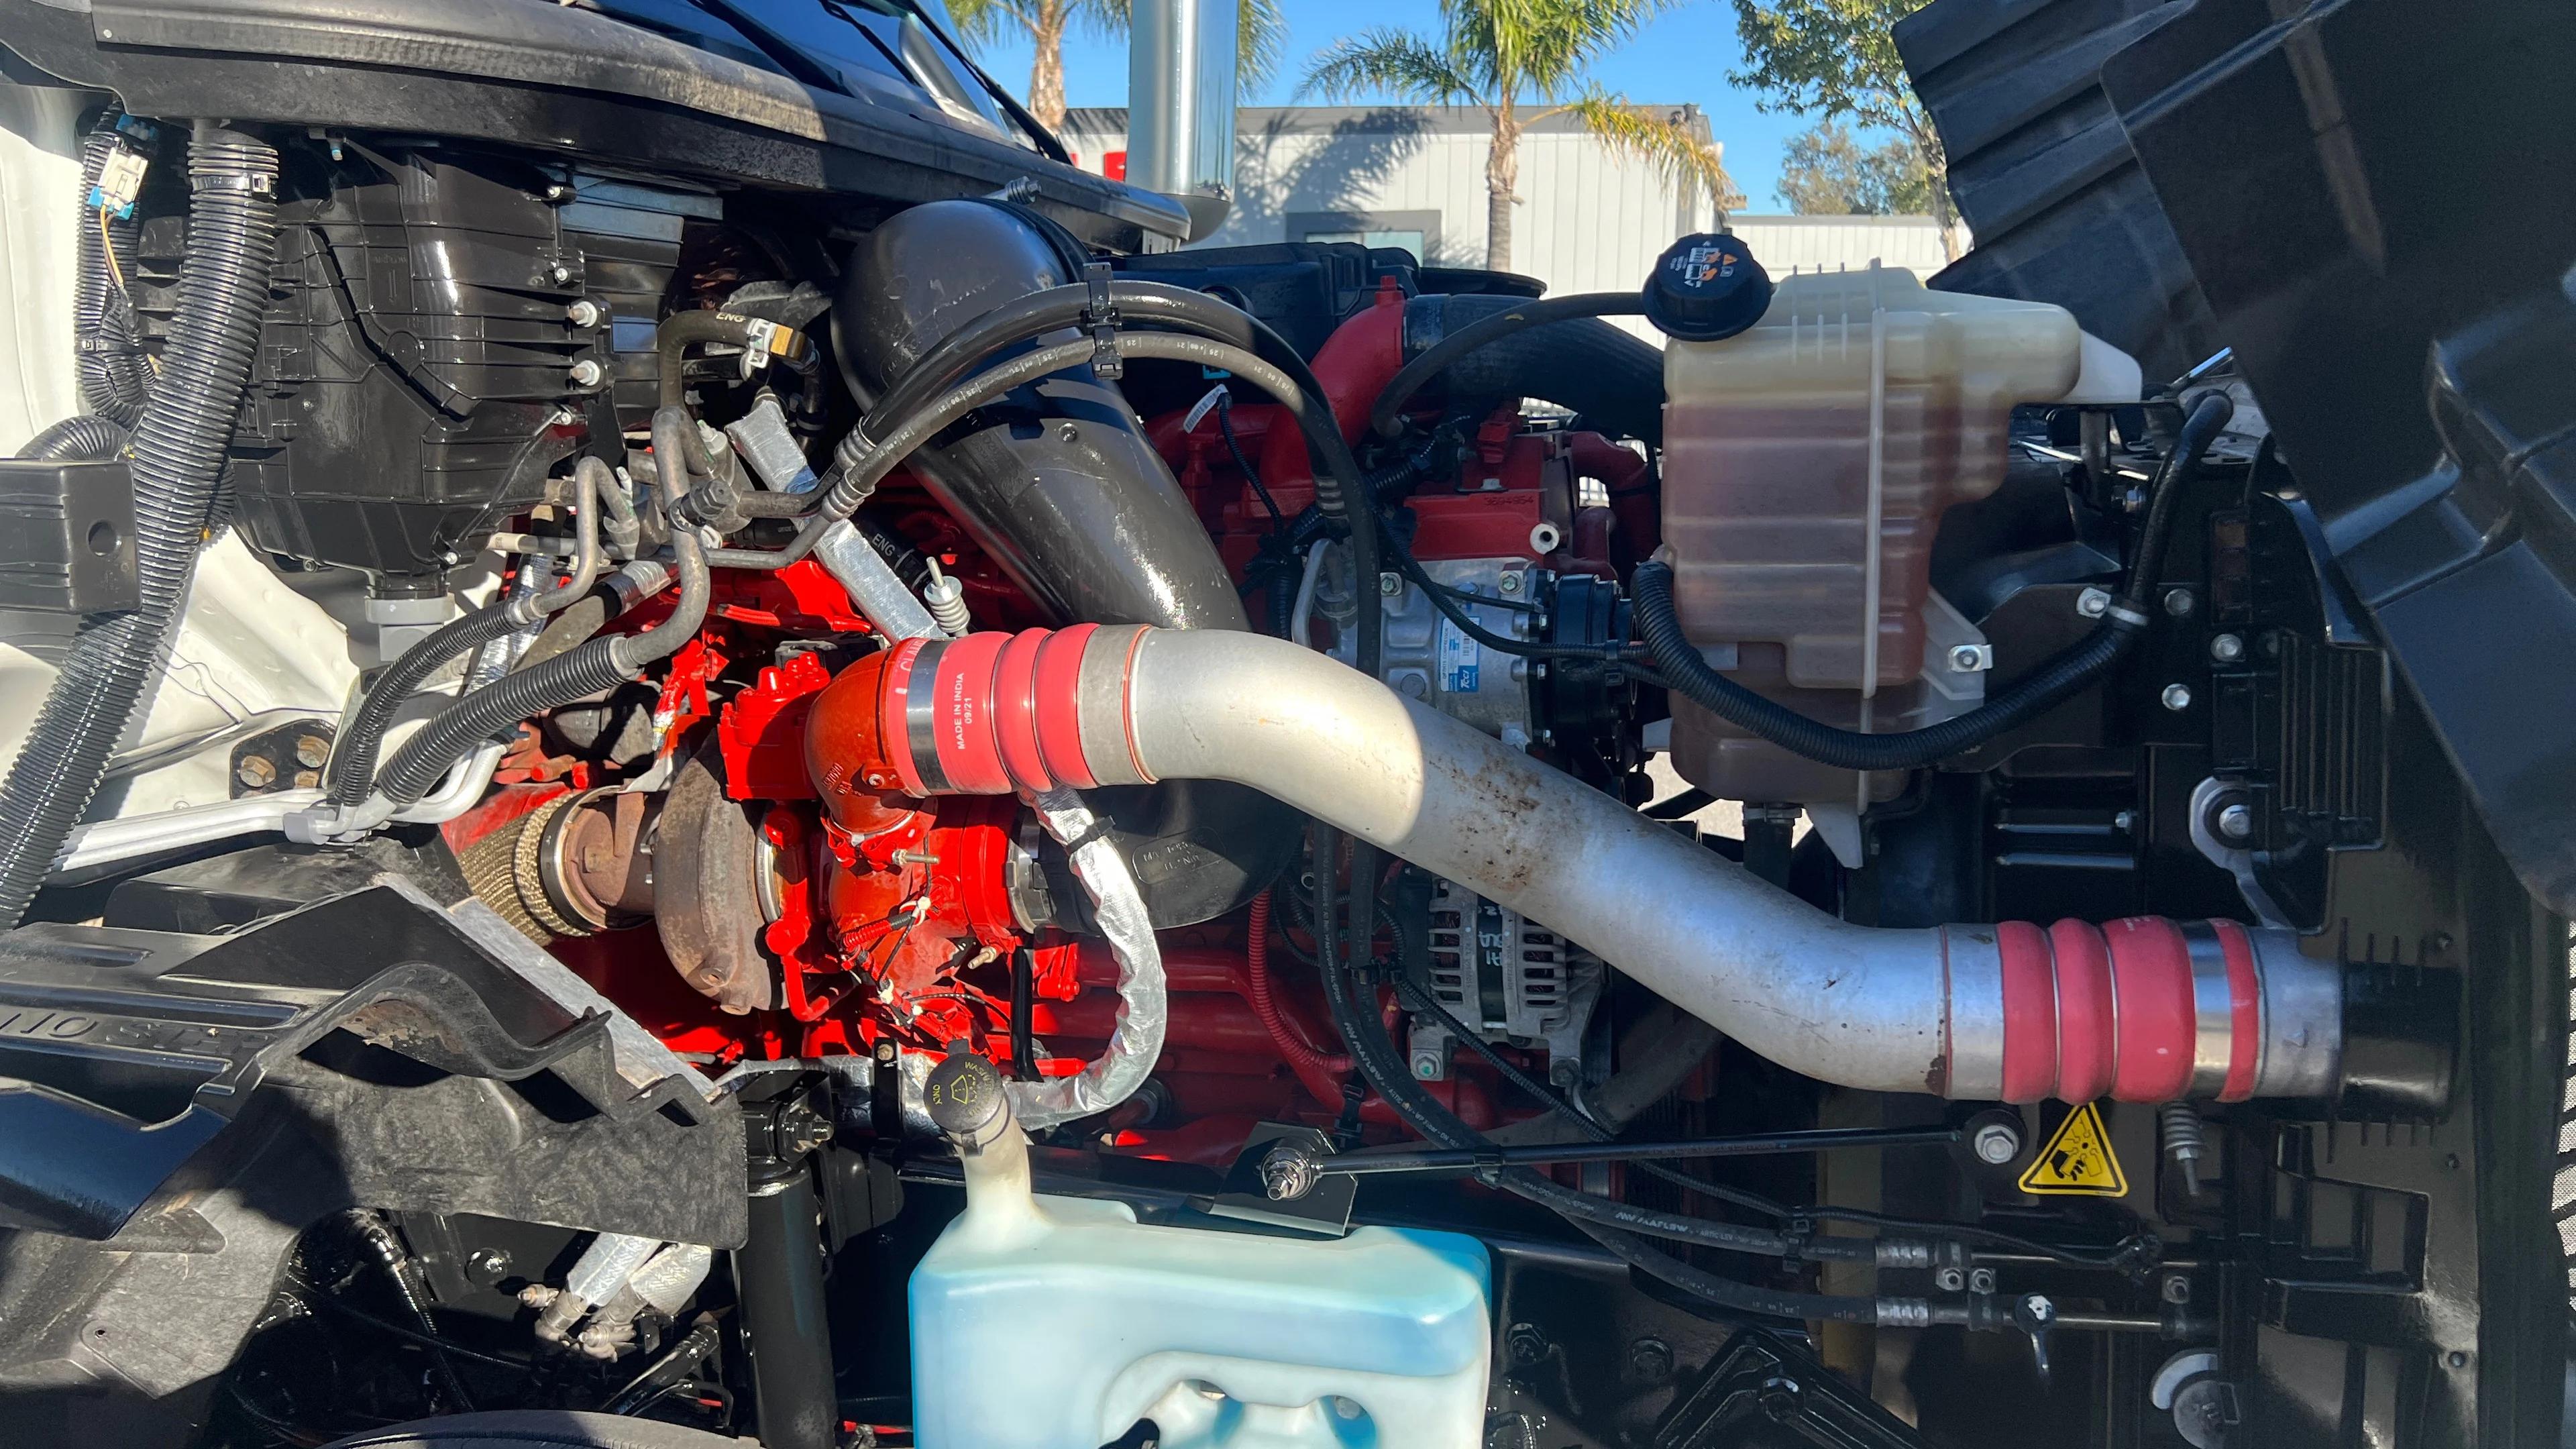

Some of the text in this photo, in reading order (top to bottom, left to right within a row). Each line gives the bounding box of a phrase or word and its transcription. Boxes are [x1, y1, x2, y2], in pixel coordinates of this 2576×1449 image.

[716, 311, 746, 323] ENG
[938, 387, 976, 414] 25 00 21
[871, 533, 896, 557] ENG
[953, 673, 965, 749] MADE IN INDIA
[964, 697, 973, 724] 09/21
[932, 1084, 943, 1106] ONLY
